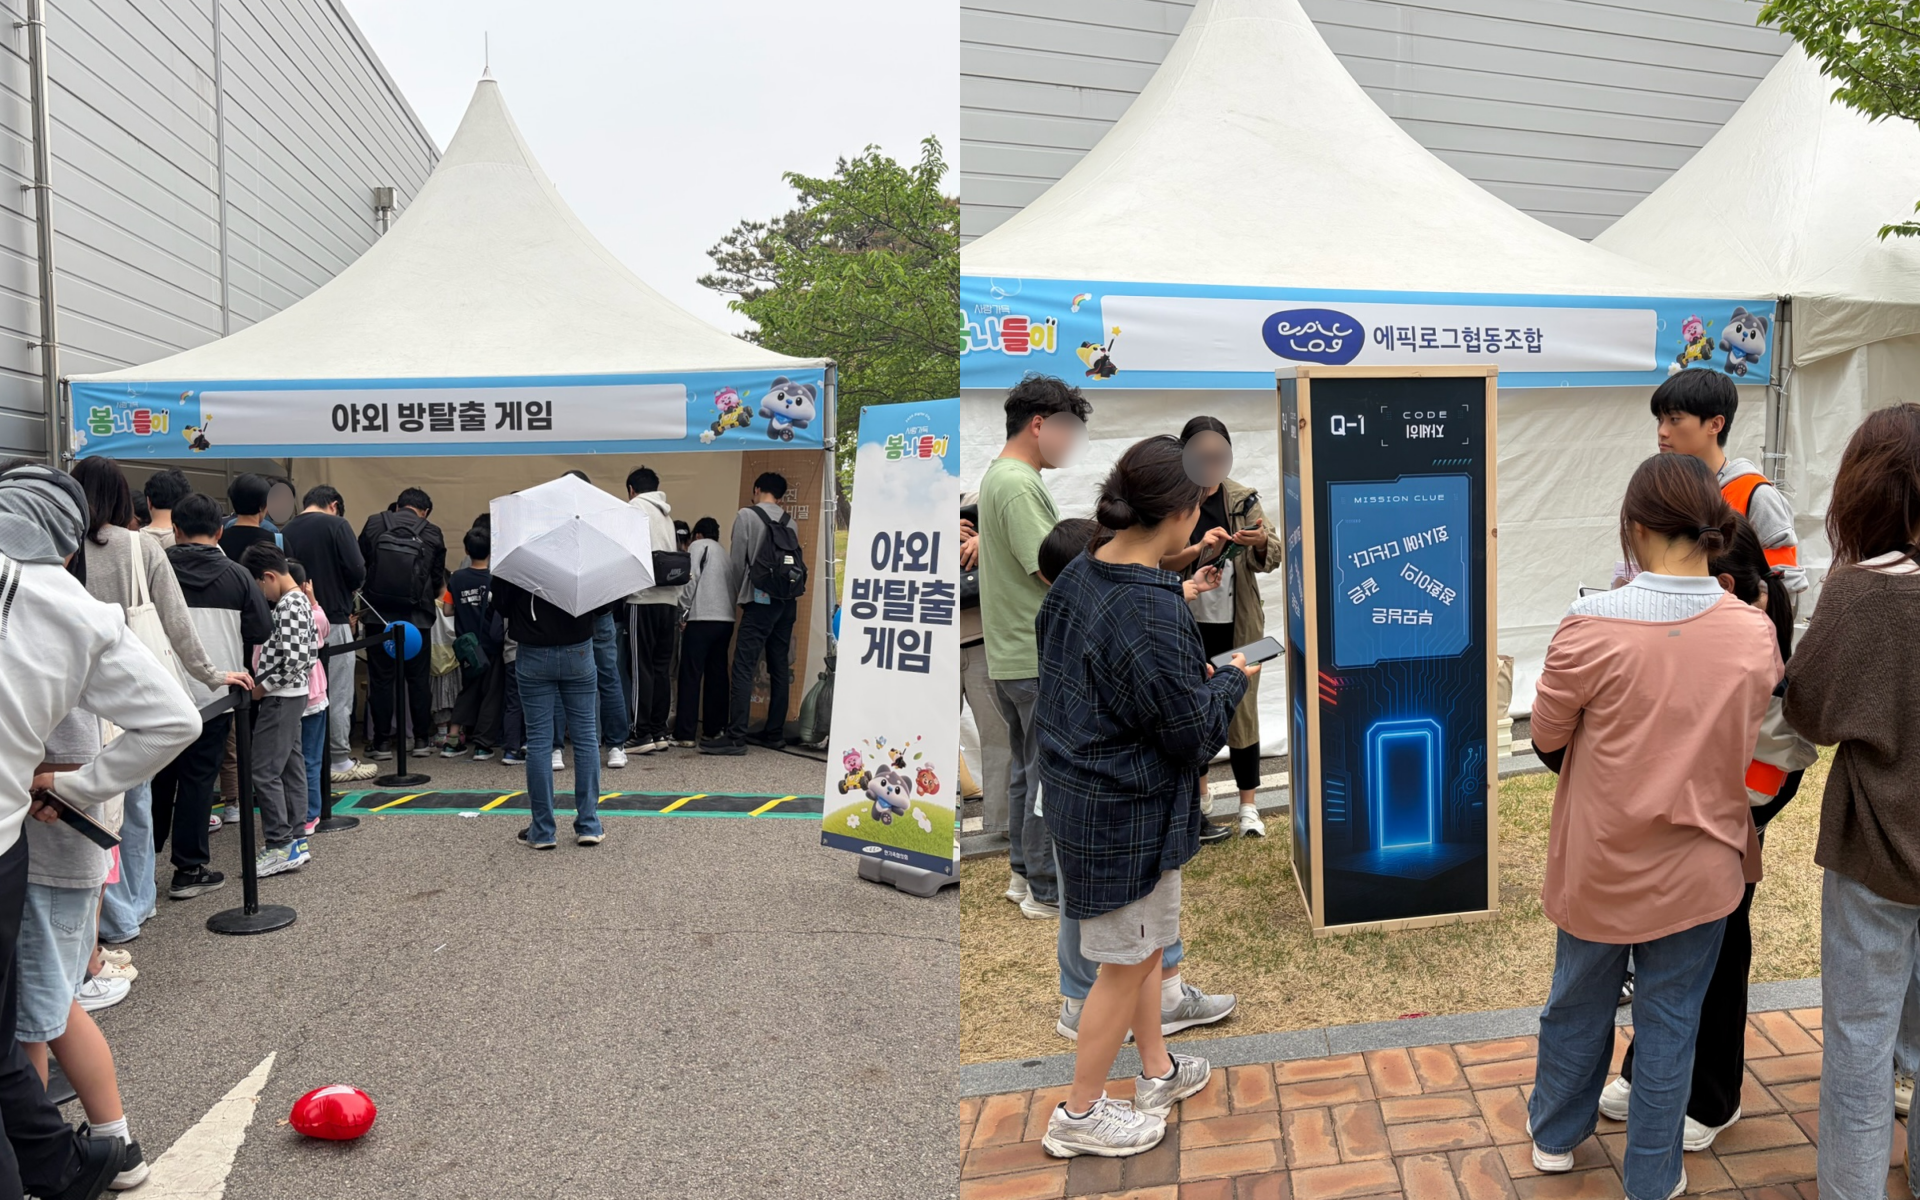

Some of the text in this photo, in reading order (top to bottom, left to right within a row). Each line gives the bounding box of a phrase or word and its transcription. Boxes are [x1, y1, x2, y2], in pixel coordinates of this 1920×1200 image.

[1373, 324, 1544, 353] 에픽로그협동조합
[88, 406, 169, 435] 봄나들이
[332, 400, 553, 433] 야외 방탈출 게임
[1330, 414, 1366, 436] Q-1
[1402, 410, 1448, 420] CODE
[1405, 423, 1445, 439] 자세히
[884, 433, 950, 461] 봄나들이
[1354, 494, 1445, 504] MISSION CLUE
[870, 530, 941, 575] 야외
[1348, 525, 1450, 569] 회사에 다닌다.
[1347, 562, 1457, 606] 정환이의 같은
[850, 577, 957, 627] 방탈출
[1371, 607, 1434, 626] 부모님은
[860, 627, 933, 674] 게임
